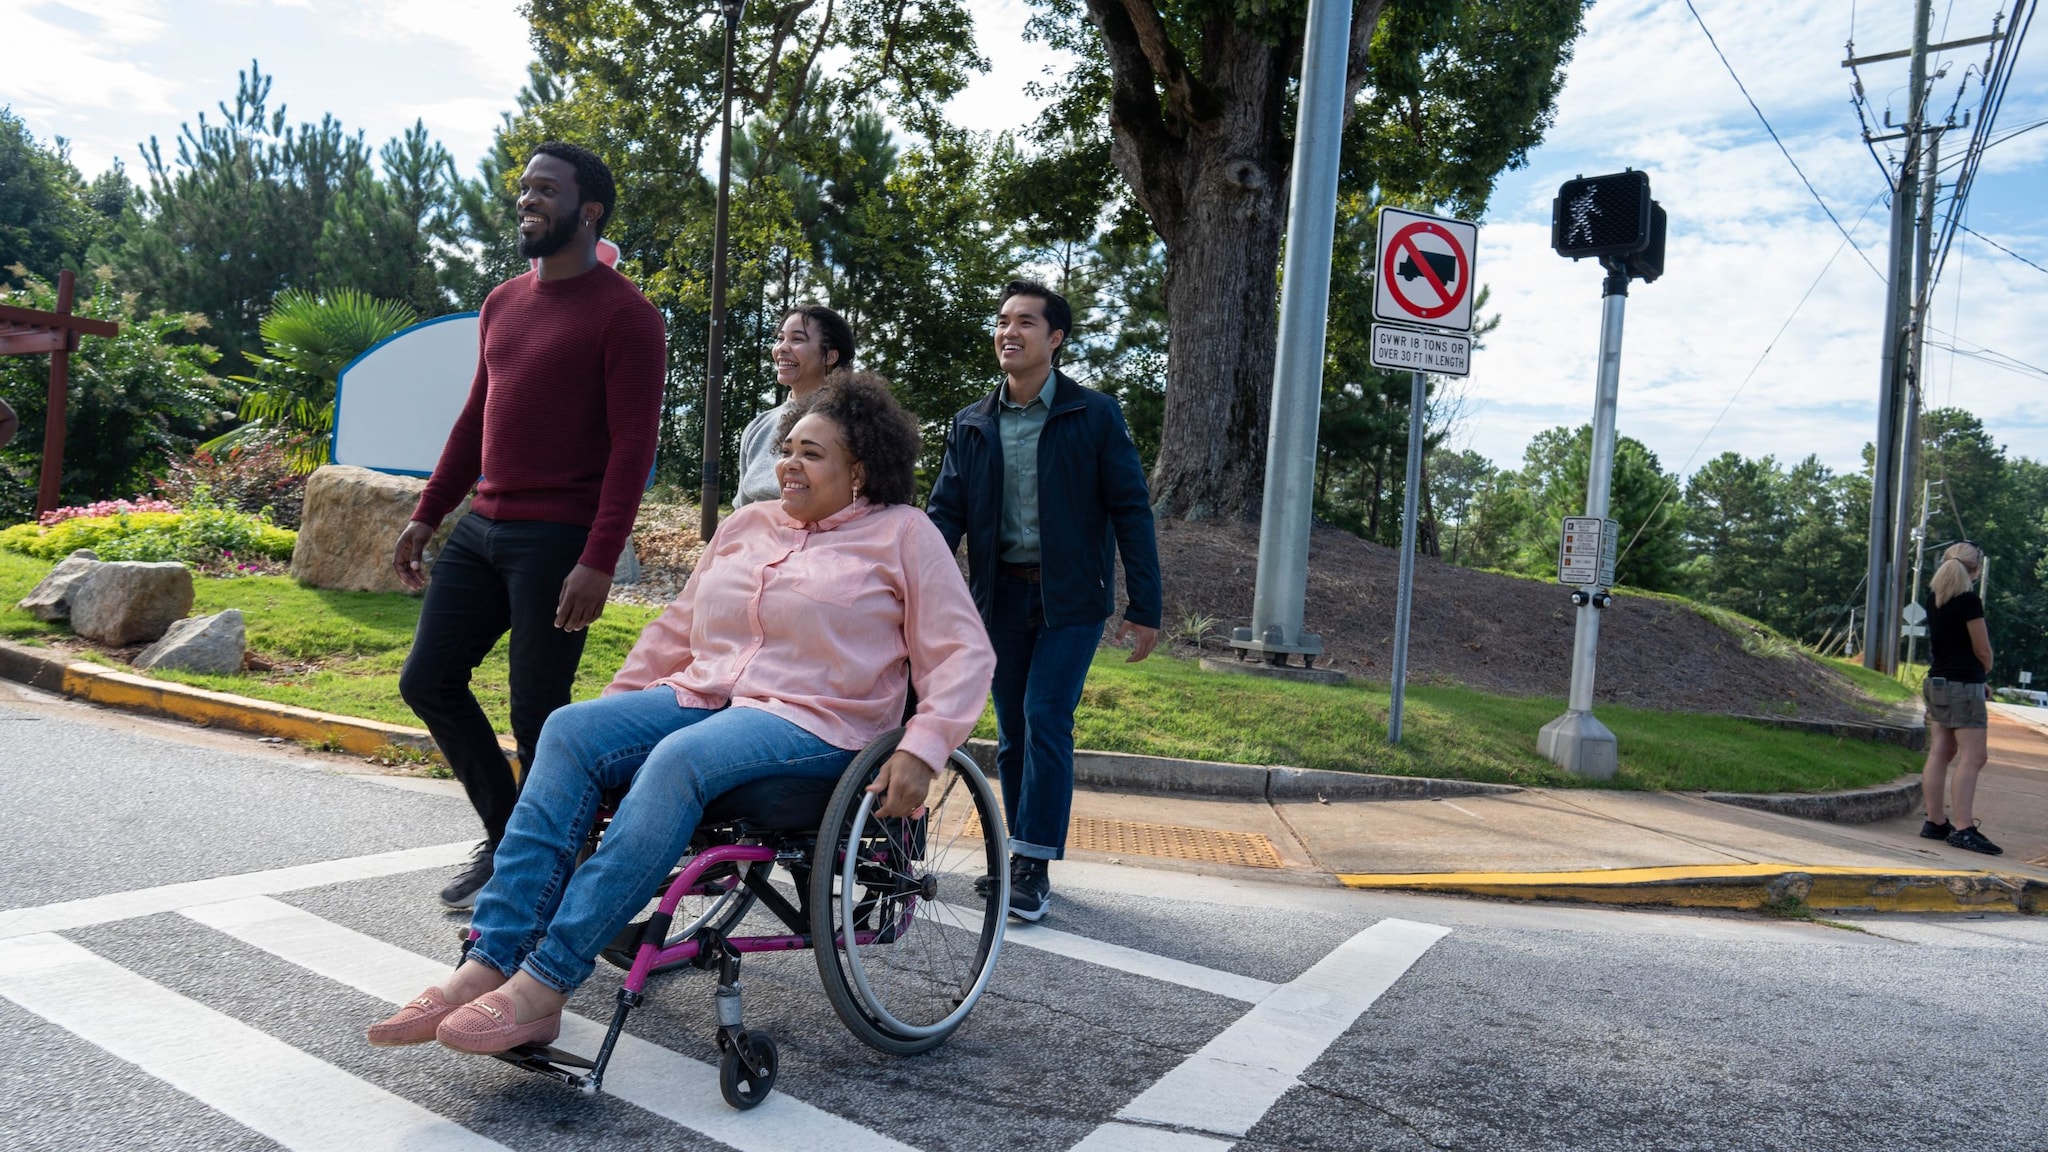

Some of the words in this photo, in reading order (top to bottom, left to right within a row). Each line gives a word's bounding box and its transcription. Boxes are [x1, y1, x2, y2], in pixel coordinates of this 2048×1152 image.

[1380, 333, 1407, 347] GVWR
[1410, 338, 1420, 348] 18
[1424, 339, 1448, 352] TONS
[1451, 343, 1464, 354] OR
[1378, 348, 1398, 360] OVER
[1401, 350, 1411, 362] 30
[1414, 352, 1423, 363] FT
[1425, 353, 1433, 364] IN
[1435, 355, 1464, 368] LENGTH
